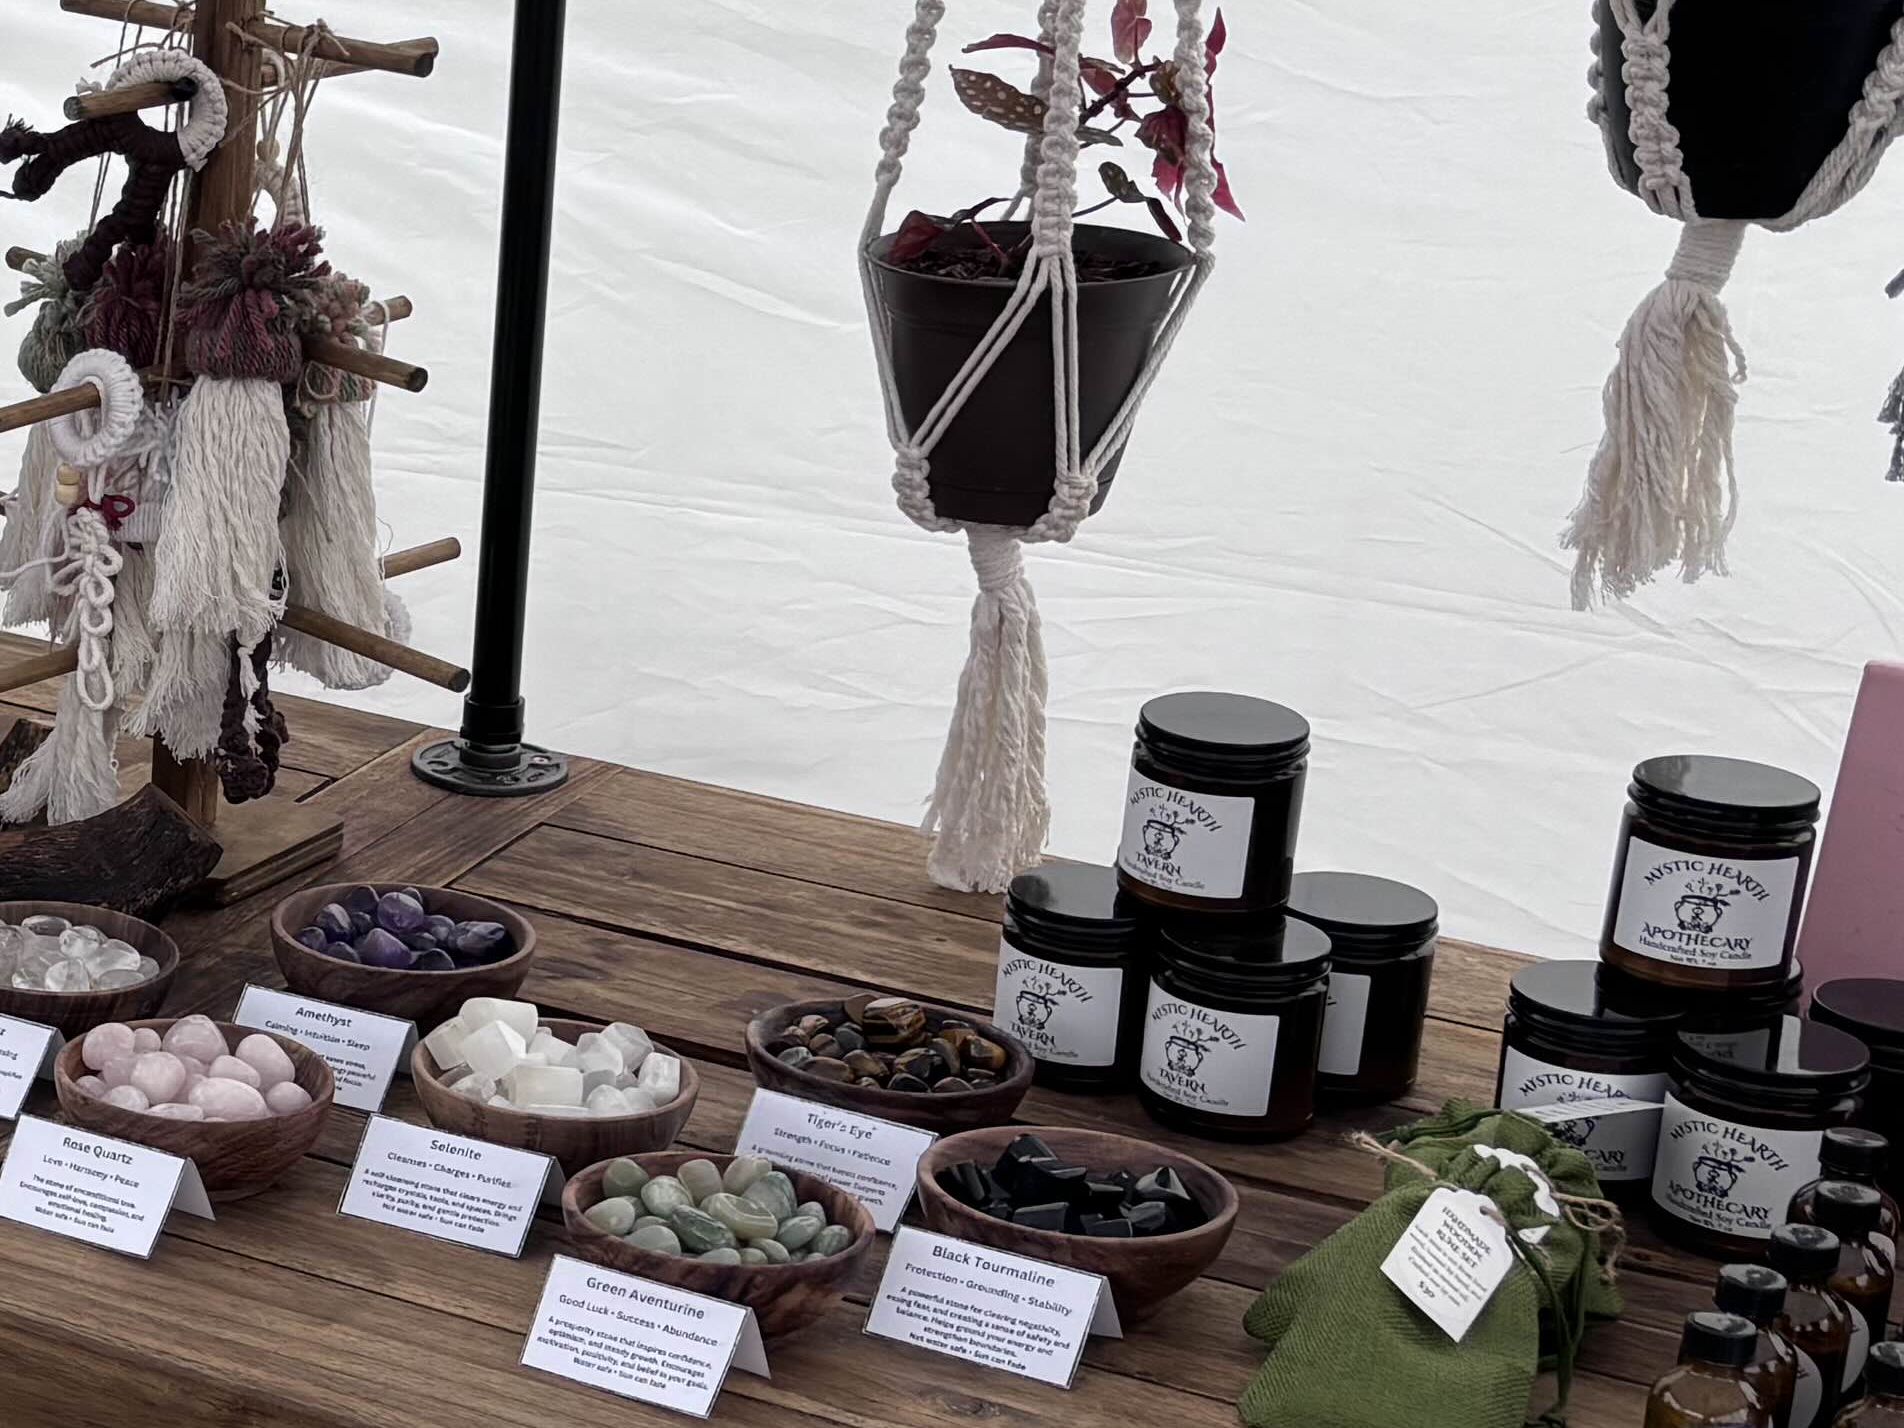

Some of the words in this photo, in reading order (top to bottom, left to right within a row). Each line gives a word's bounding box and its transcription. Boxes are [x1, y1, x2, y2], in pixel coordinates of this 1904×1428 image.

[1167, 790, 1222, 832] HEARTH
[1136, 852, 1182, 877] TAVERN
[1644, 860, 1704, 886] MYSTIC
[1708, 862, 1770, 901] HEARTH
[1640, 935, 1696, 957] Handcrafted
[1699, 949, 1717, 959] Soy
[1720, 950, 1751, 960] Candle
[1642, 922, 1752, 951] APOTHECARY
[296, 1007, 352, 1028] Amethyst
[1190, 1008, 1246, 1050] HEARTH
[265, 1020, 297, 1036] Calming
[305, 1030, 340, 1044] Intuition
[347, 1039, 370, 1051] Sleep
[1010, 1020, 1056, 1048] TAVERN
[1160, 1068, 1207, 1094] TAVERN
[1519, 1073, 1573, 1097] MYSTIC
[774, 1127, 812, 1146] Strength
[819, 1139, 846, 1155] Focus
[807, 1113, 846, 1133] Tiger's
[849, 1125, 872, 1140] Eye
[63, 1137, 91, 1154] Rose
[93, 1145, 133, 1165] Quartz
[430, 1139, 482, 1161] Selenite
[1670, 1121, 1719, 1141] MYSTIC
[1723, 1126, 1789, 1172] HEARTH
[43, 1155, 62, 1166] Love
[69, 1162, 108, 1182] Harmony
[115, 1174, 139, 1188] Peace
[387, 1152, 427, 1168] Cleanses
[434, 1163, 470, 1179] Charges
[1667, 1179, 1773, 1221] APOTHECARY
[932, 1245, 969, 1266] Black
[975, 1256, 1055, 1288] Tourmaline
[586, 1277, 627, 1298] Green
[629, 1289, 704, 1319] Aventurine
[905, 1262, 958, 1285] Protection
[966, 1279, 1020, 1303] Grounding
[1028, 1296, 1072, 1317] Stability
[559, 1294, 585, 1309] Good
[586, 1302, 609, 1316] Luck
[616, 1311, 655, 1330] Success
[663, 1324, 718, 1347] Abundance
